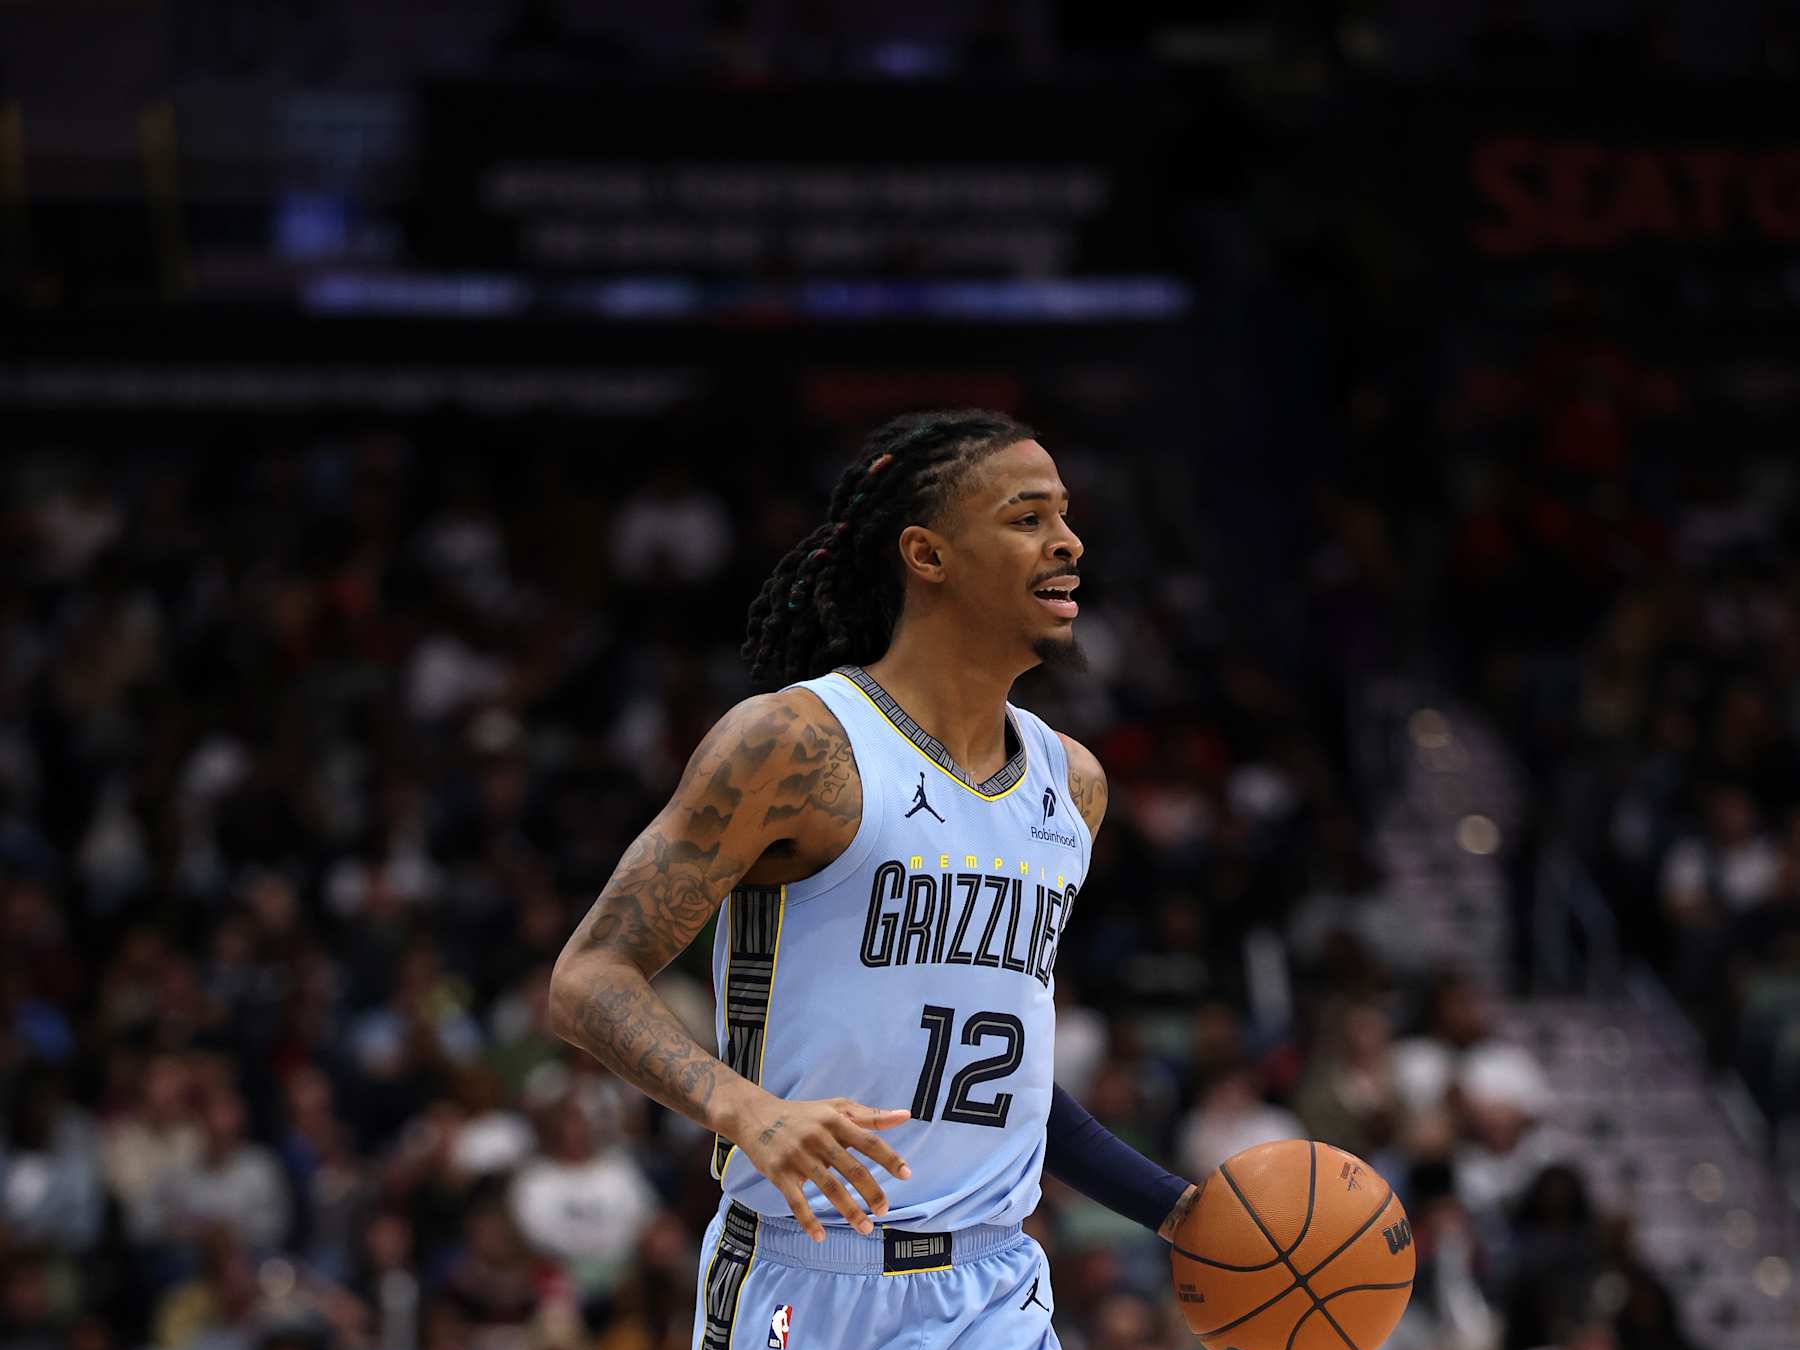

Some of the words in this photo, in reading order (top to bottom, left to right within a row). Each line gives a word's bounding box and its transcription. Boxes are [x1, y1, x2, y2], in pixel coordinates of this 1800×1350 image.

[1030, 826, 1077, 848] Robinhood
[909, 854, 1064, 889] MEMPHIS
[911, 1004, 1025, 1128] 12
